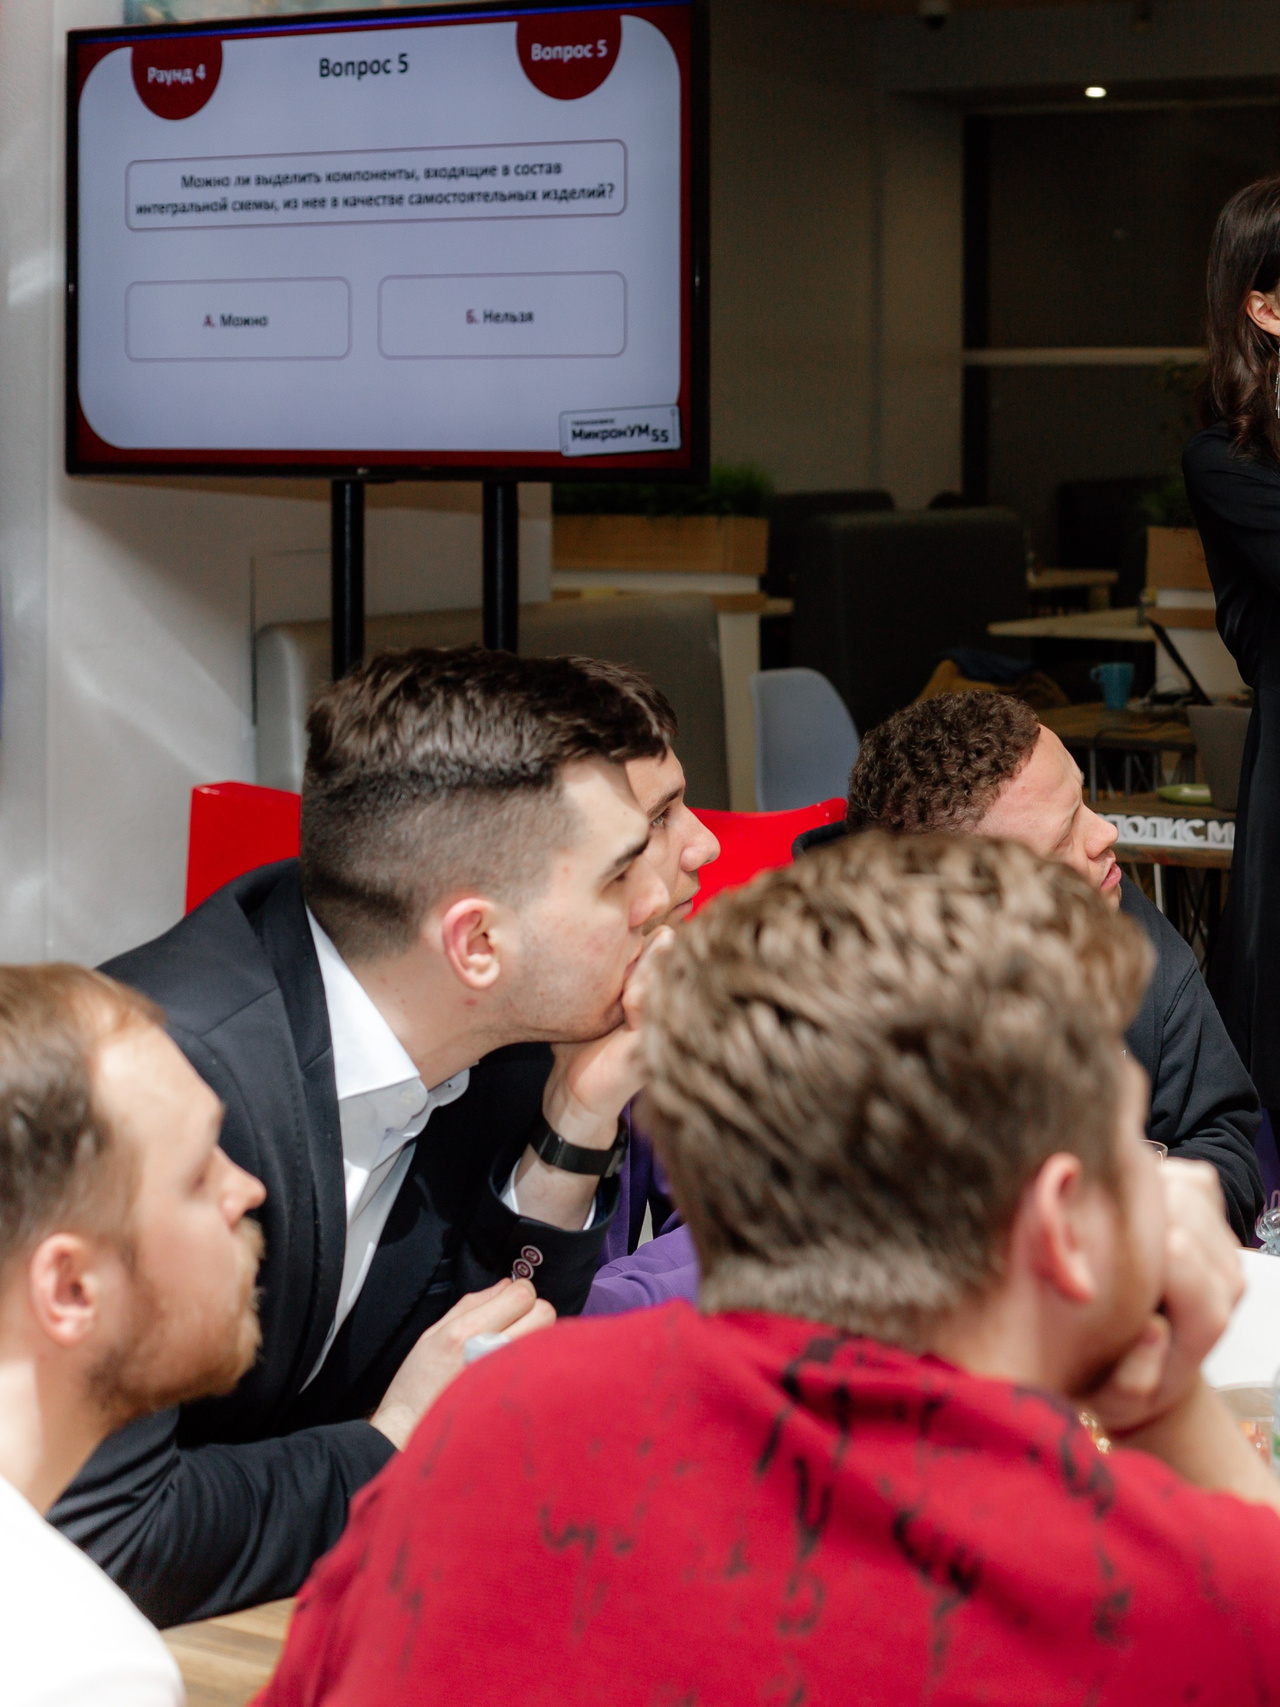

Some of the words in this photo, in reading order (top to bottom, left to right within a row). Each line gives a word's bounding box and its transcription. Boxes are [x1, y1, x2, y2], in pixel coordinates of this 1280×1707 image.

[530, 43, 594, 63] Вопрос
[597, 39, 608, 58] 5
[147, 66, 193, 86] Раунд
[195, 63, 207, 81] 4
[319, 57, 392, 81] Вопрос
[398, 53, 409, 74] 5
[181, 174, 231, 189] Можно
[233, 174, 250, 187] ли
[254, 171, 322, 188] выделить
[325, 168, 420, 184] компоненты,
[424, 165, 498, 180] входящие
[501, 164, 511, 177] в
[514, 162, 563, 176] состав
[136, 197, 228, 216] интегральной
[231, 198, 279, 213] схемы,
[283, 197, 299, 210] из
[302, 196, 326, 209] нее
[330, 195, 339, 208] в
[343, 193, 404, 208] качестве
[408, 189, 538, 206] самостоятельных
[542, 182, 615, 203] изделий?
[220, 314, 269, 328] Можно
[483, 309, 535, 324] Нельзя
